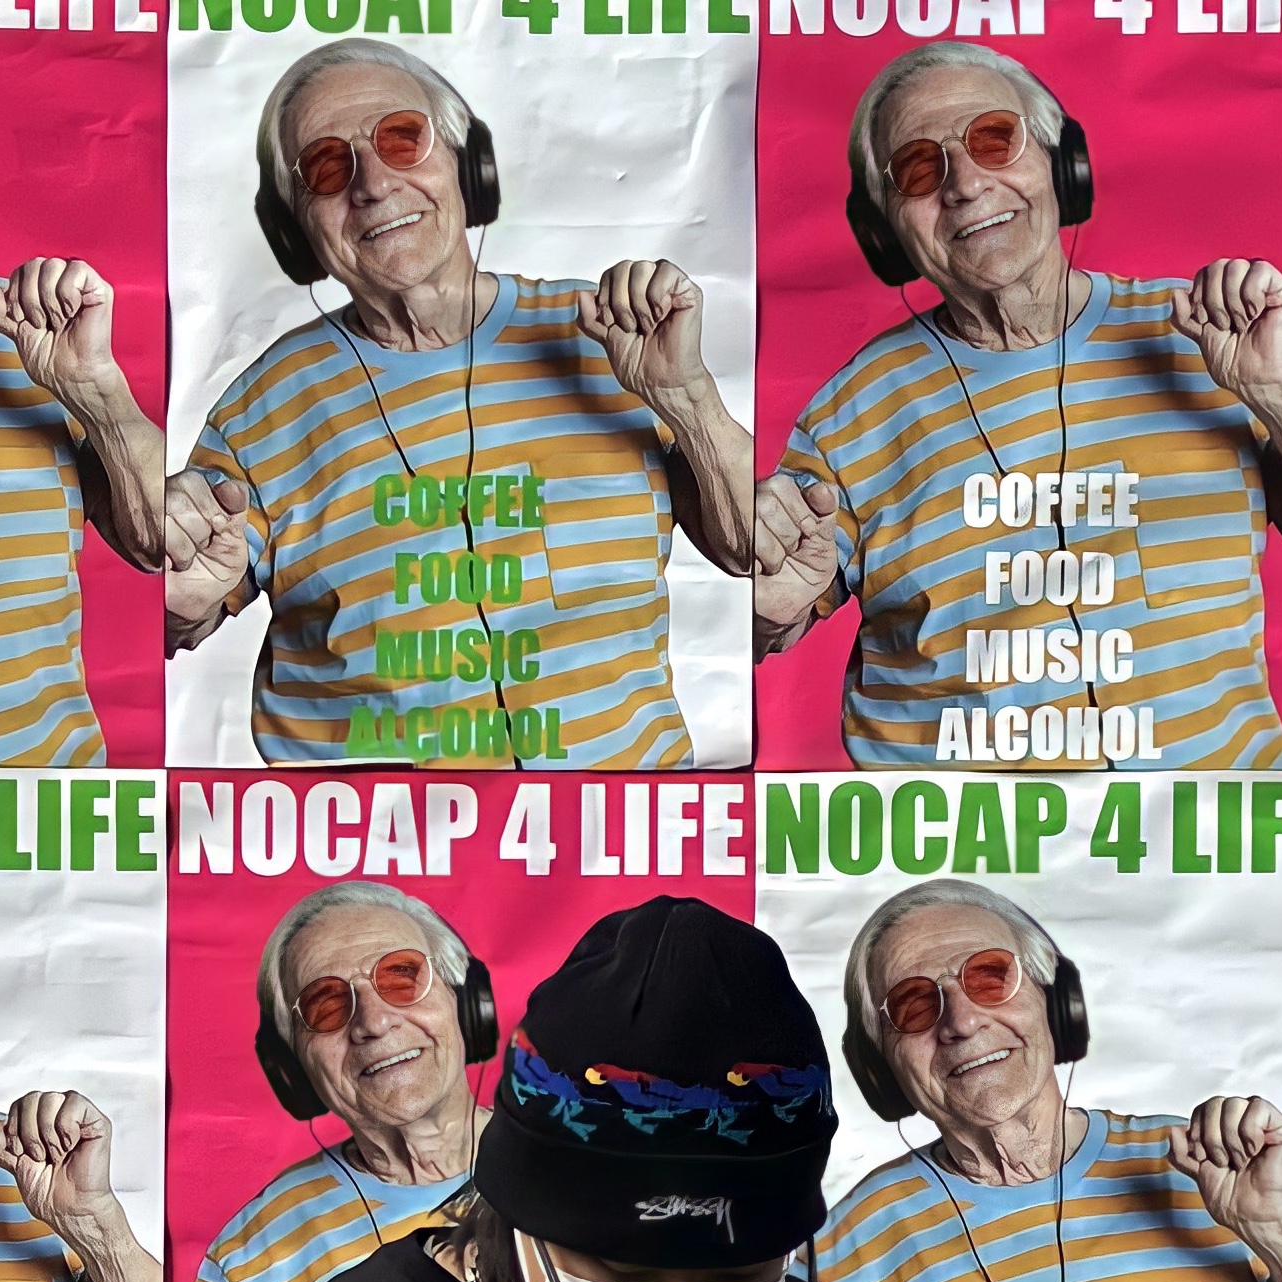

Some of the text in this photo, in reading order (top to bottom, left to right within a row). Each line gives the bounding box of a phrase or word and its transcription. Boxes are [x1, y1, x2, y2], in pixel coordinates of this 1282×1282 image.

[373, 474, 545, 529] COFFEE
[962, 474, 1139, 529] COFFEE
[394, 552, 523, 604] FOOD
[984, 553, 1114, 606] FOOD
[374, 628, 539, 684] MUSIC
[964, 629, 1133, 683] MUSIC
[344, 707, 567, 761] ALCOHOL
[935, 707, 1162, 762] ALCOHOL
[180, 781, 745, 876] NOCAP 4 LIFE
[766, 781, 1067, 875] NOCAP
[1090, 782, 1146, 873] 4
